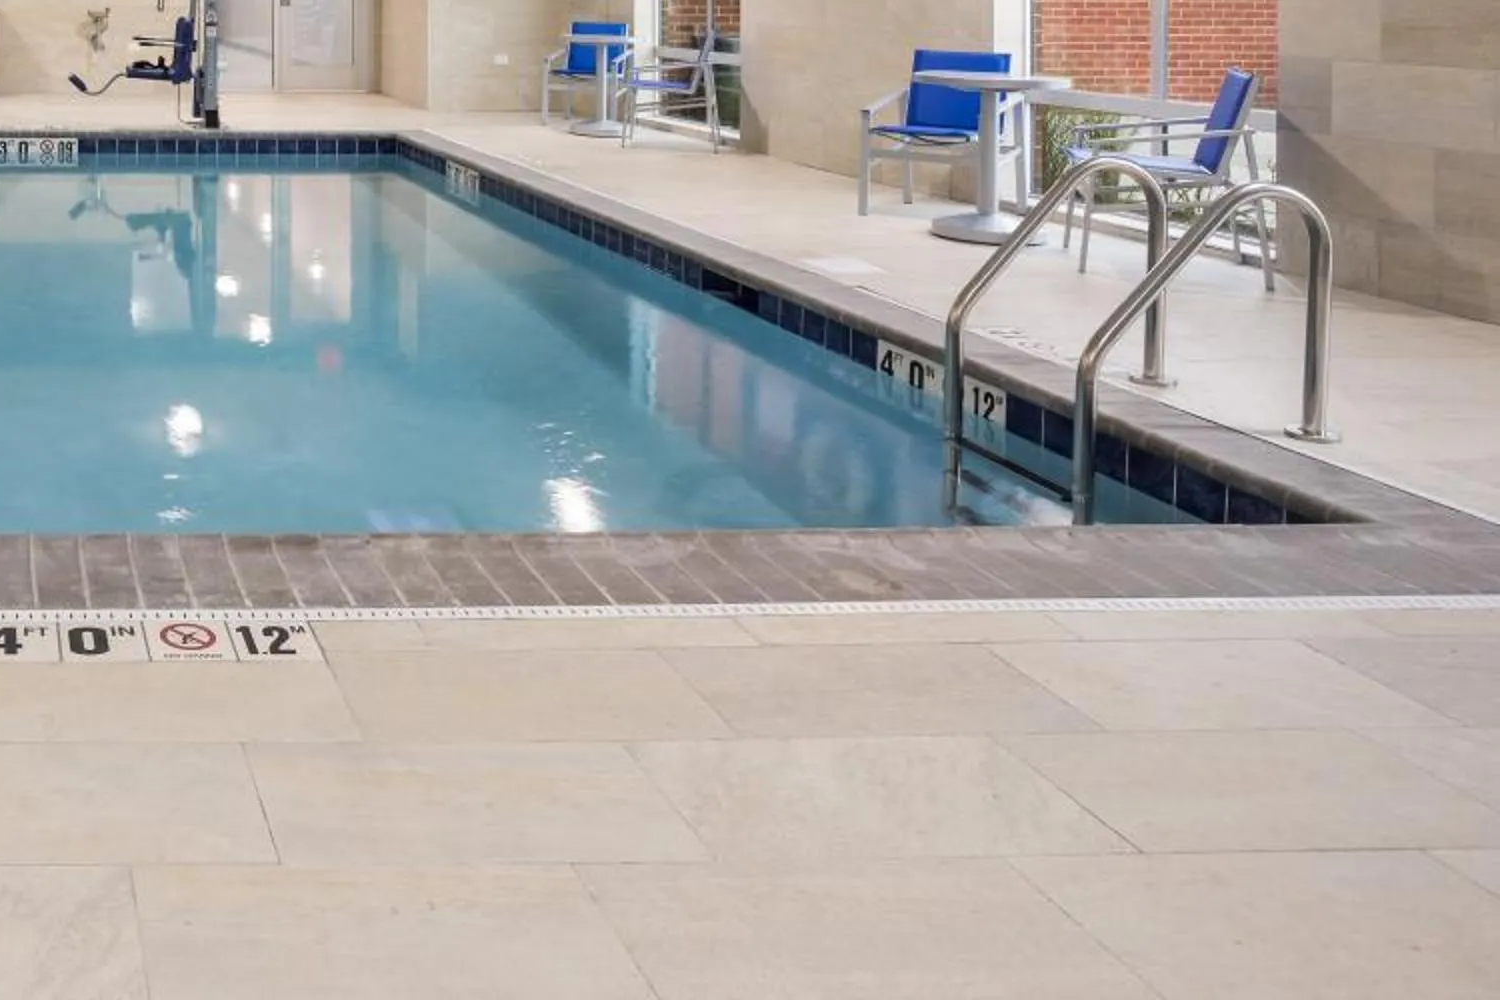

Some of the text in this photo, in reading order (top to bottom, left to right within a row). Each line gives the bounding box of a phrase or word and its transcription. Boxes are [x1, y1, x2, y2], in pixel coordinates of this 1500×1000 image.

[880, 350, 894, 377] 4
[909, 360, 924, 389] 0
[67, 627, 110, 655] 0
[110, 625, 136, 637] IN
